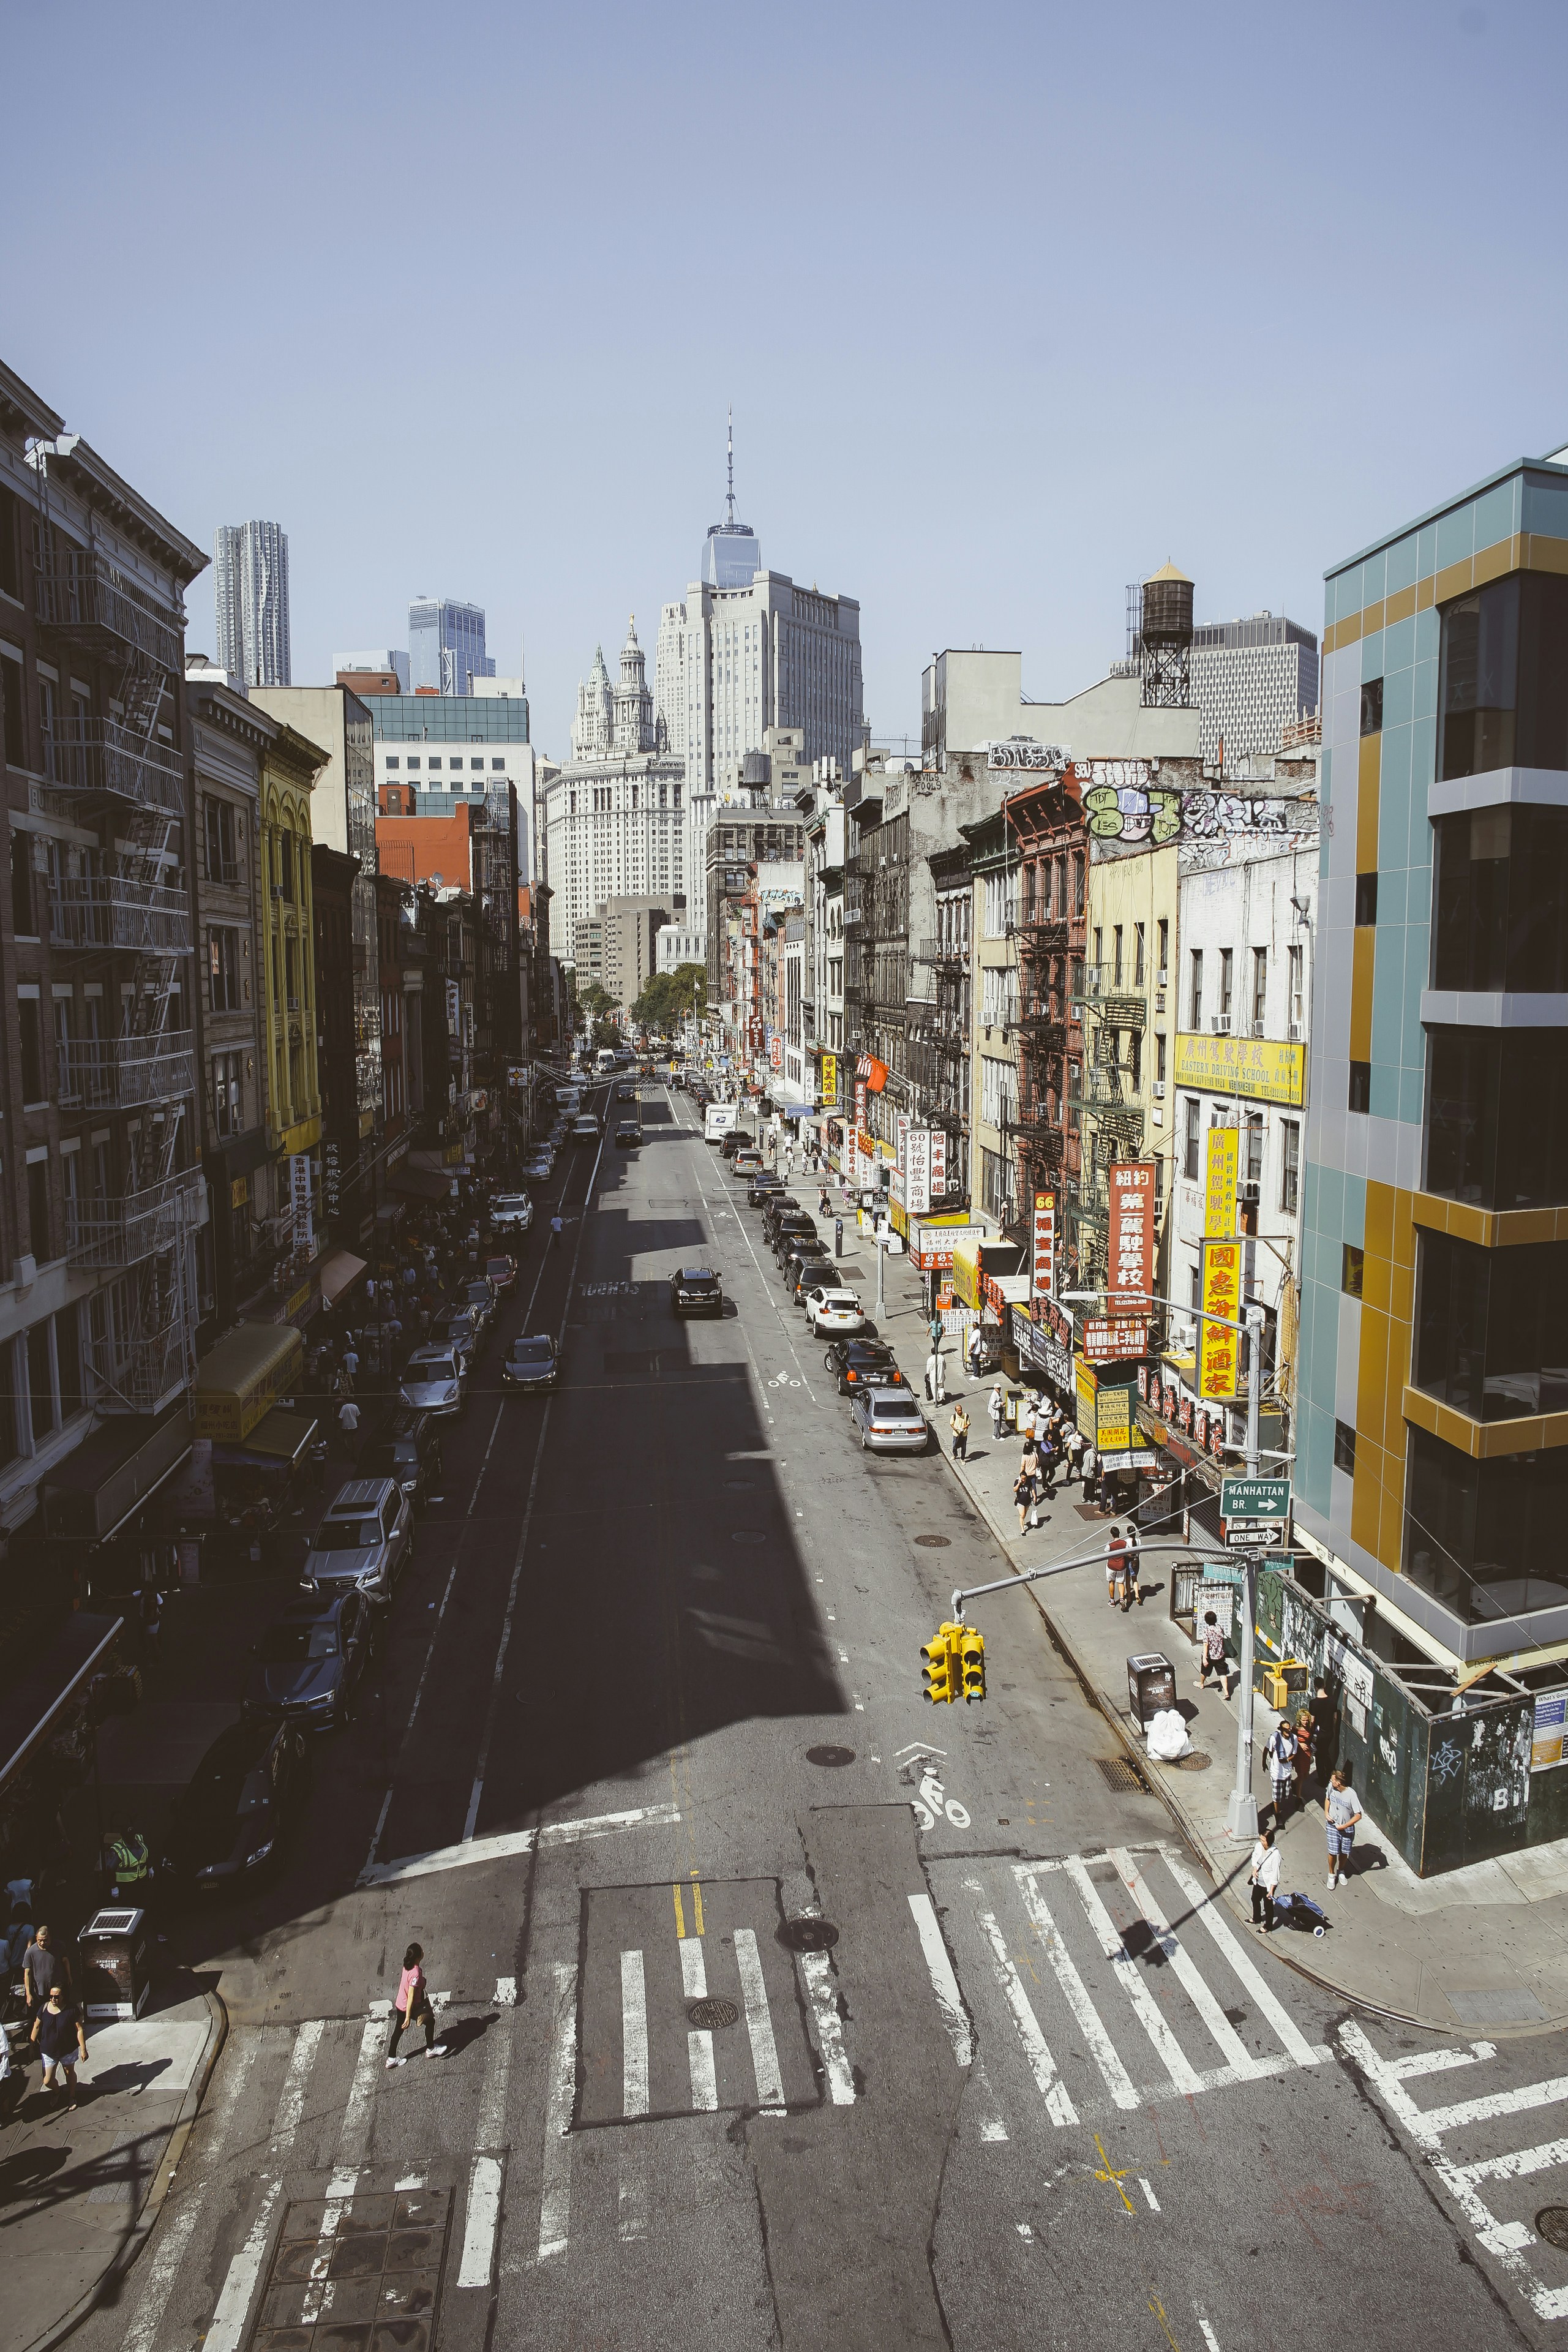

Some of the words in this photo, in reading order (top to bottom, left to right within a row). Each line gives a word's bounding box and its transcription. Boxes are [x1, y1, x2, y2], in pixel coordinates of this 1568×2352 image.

[1185, 1038, 1264, 1067] 廣州駕駛學校
[1181, 1059, 1209, 1073] EASTERN
[1212, 1064, 1239, 1078] DRIVING
[1242, 1068, 1270, 1083] SCHOOL
[1116, 1170, 1149, 1187] 紐約
[1209, 1133, 1225, 1238] 廣州駕駛學
[1035, 1196, 1054, 1209] 66
[1117, 1193, 1144, 1287] 第一駕駛學校
[1043, 1322, 1052, 1337] 66
[1204, 1246, 1239, 1394] 國惠海鮮酒家
[1013, 1323, 1032, 1353] LEASE
[1046, 1350, 1070, 1383] RETAIL
[1229, 1486, 1285, 1496] MANHATTAN
[1232, 1499, 1247, 1509] BR.
[1234, 1533, 1250, 1542] ONE
